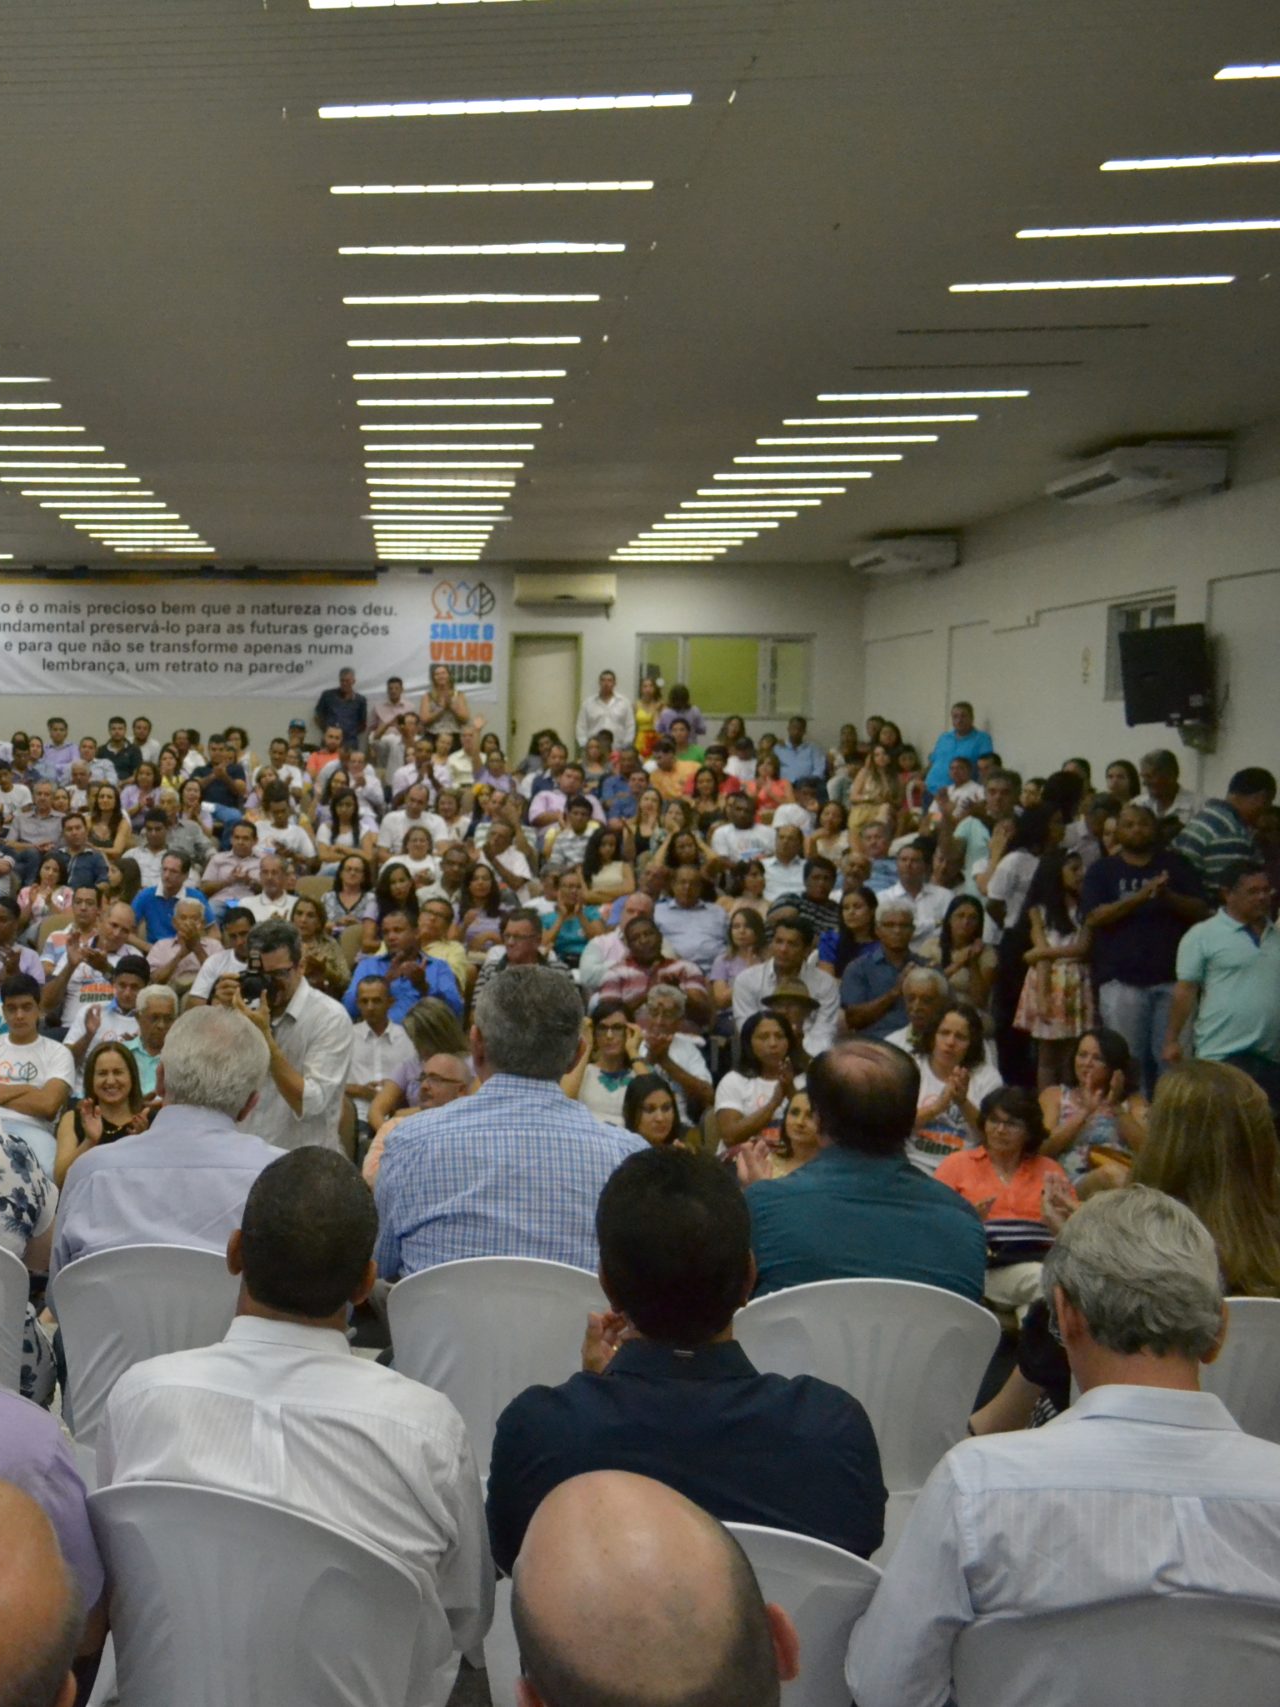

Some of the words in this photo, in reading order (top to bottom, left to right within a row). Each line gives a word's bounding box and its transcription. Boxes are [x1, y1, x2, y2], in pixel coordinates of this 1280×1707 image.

[15, 601, 24, 614] é
[29, 604, 39, 614] o
[44, 601, 81, 614] mais
[87, 601, 157, 617] precioso
[161, 601, 196, 615] bem
[201, 603, 231, 617] que
[236, 604, 246, 615] a
[251, 603, 321, 616] natureza
[326, 605, 357, 616] nos
[362, 602, 398, 616] deu.
[90, 620, 181, 636] preservá-lo
[185, 623, 221, 636] para
[226, 624, 245, 634] as
[250, 620, 308, 635] futuras
[313, 622, 390, 638] gerações
[430, 623, 480, 640] SALVE
[483, 624, 494, 641] O
[4, 641, 13, 652] e
[18, 641, 52, 654] para
[57, 641, 87, 655] que
[92, 639, 122, 652] não
[126, 643, 145, 653] se
[150, 640, 238, 653] transforme
[244, 643, 302, 656] apenas
[308, 644, 353, 655] numa
[430, 641, 494, 662] VELHO
[42, 658, 130, 674] lembrança,
[135, 662, 160, 672] um
[165, 660, 219, 673] retrato
[224, 663, 243, 673] na
